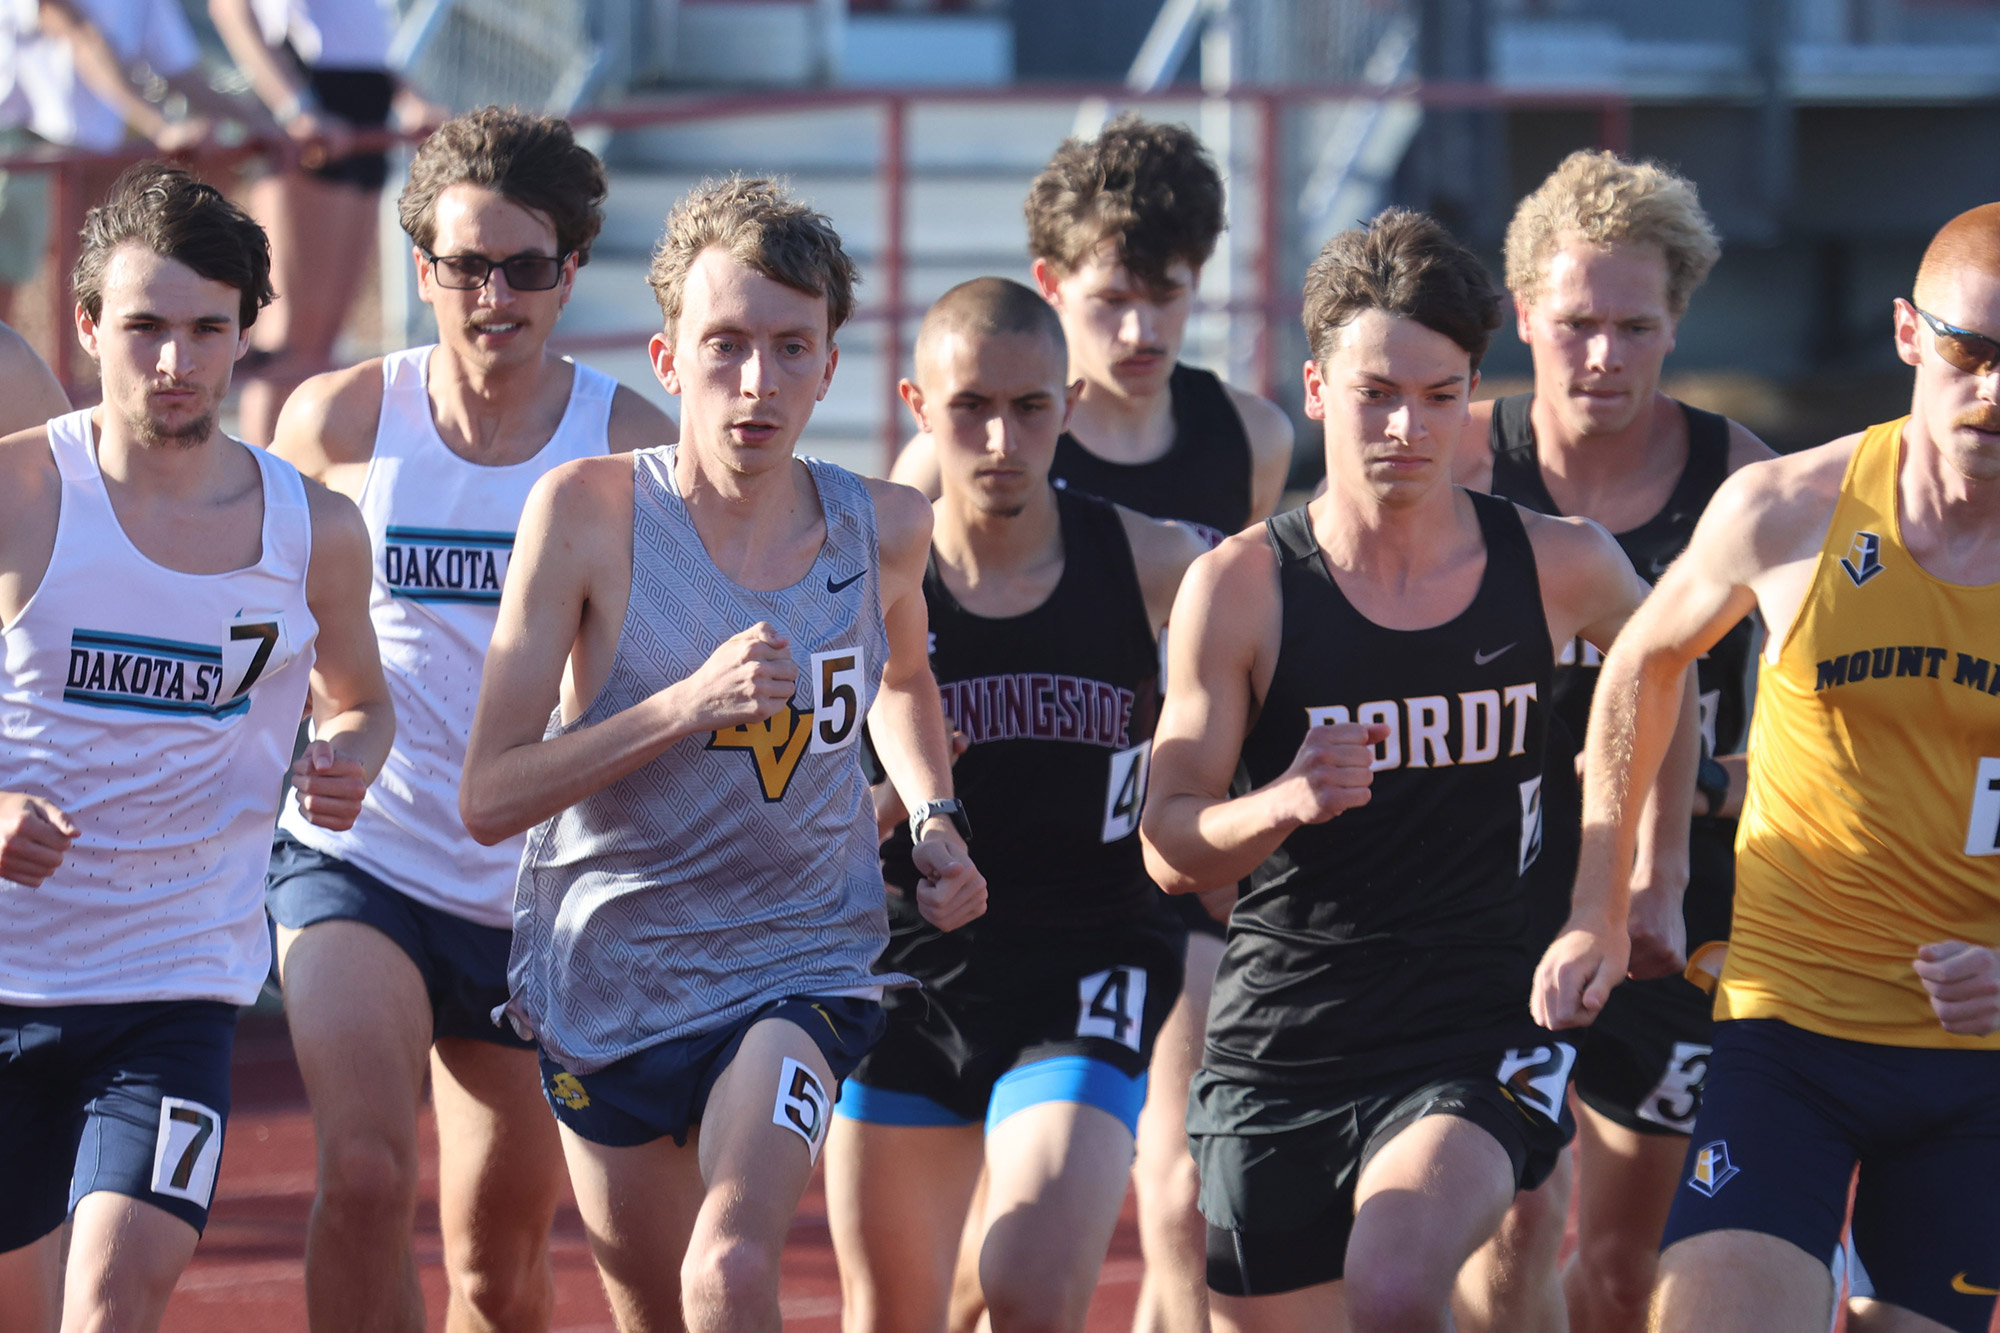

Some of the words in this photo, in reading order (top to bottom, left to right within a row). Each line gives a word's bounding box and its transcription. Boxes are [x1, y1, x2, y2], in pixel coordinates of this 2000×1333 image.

[386, 546, 500, 589] DAKOTA
[66, 649, 185, 701] DAKOTA
[230, 621, 279, 697] 7
[1814, 646, 1948, 691] MOUNT
[819, 655, 857, 745] 5
[1112, 752, 1145, 828] 4
[1089, 970, 1133, 1040] 4
[784, 1065, 825, 1144] 5
[1504, 1042, 1565, 1112] 2
[1656, 1054, 1709, 1122] 3
[169, 1106, 214, 1192] 7
